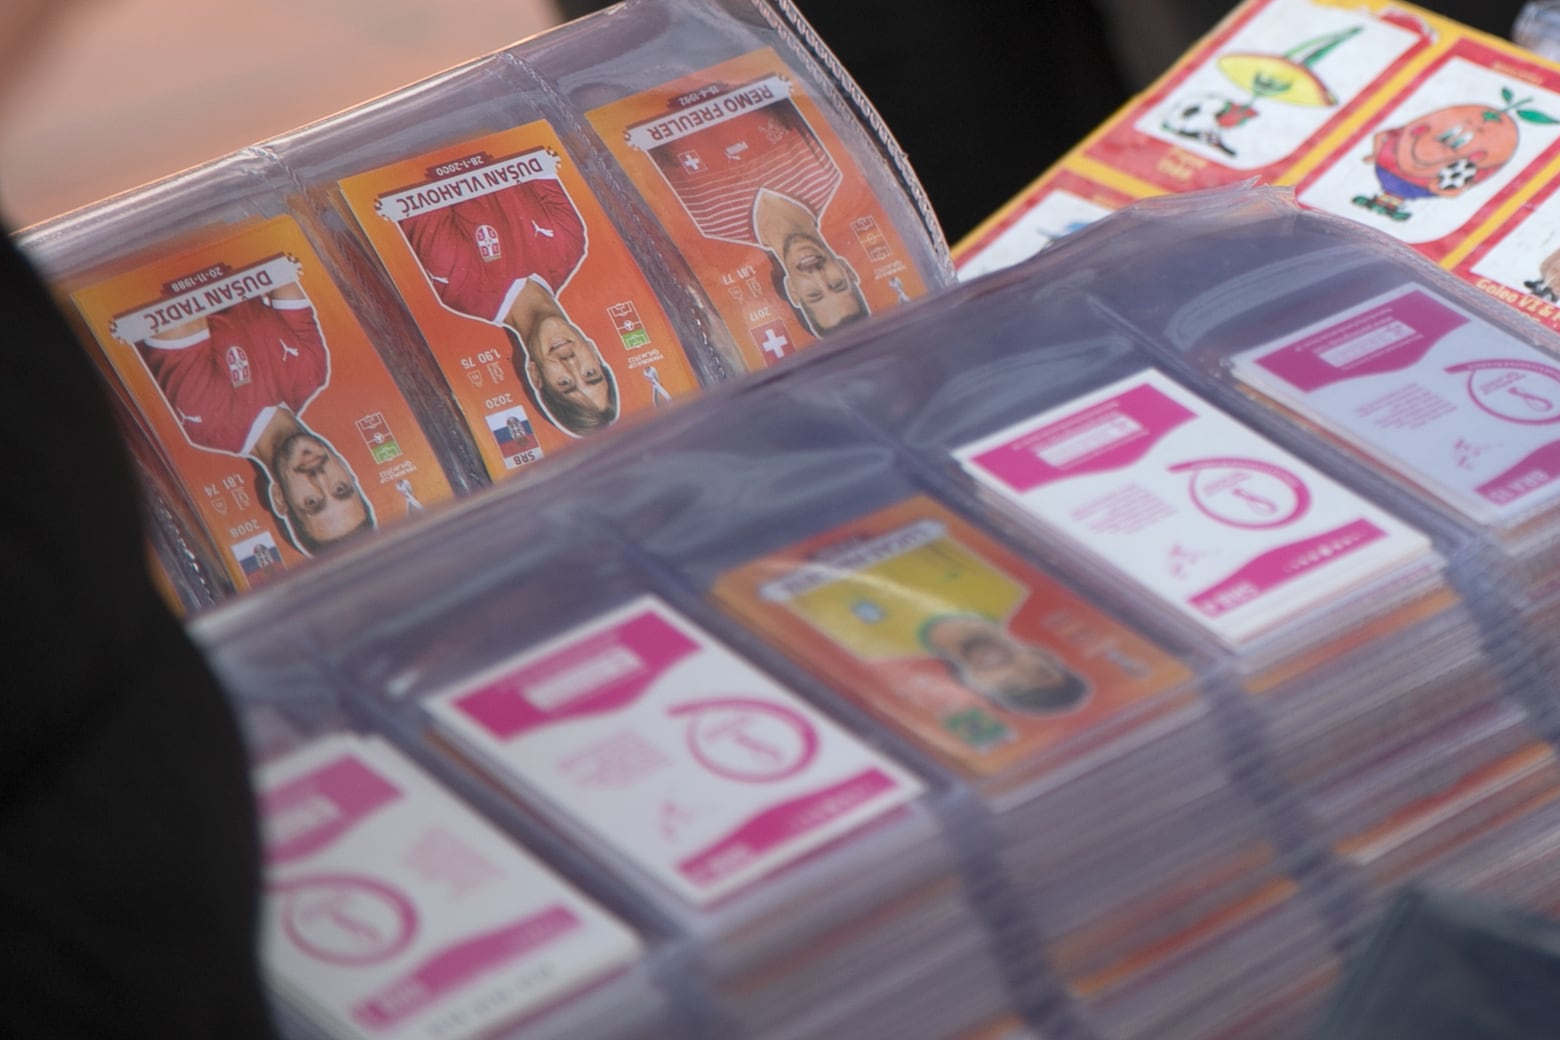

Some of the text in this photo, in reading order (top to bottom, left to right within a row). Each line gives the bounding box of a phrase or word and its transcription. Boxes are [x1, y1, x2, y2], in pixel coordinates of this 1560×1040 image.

[650, 84, 774, 141] REMO FREULER
[436, 155, 484, 176] 28-1-2000
[396, 157, 543, 214] DUŠAN VLAHOVIĆ
[143, 270, 273, 333] DUŠAN TADIĆ
[1475, 278, 1517, 303] Goleo
[486, 392, 513, 409] 2020
[513, 450, 536, 466] SRB
[229, 518, 261, 539] 2008
